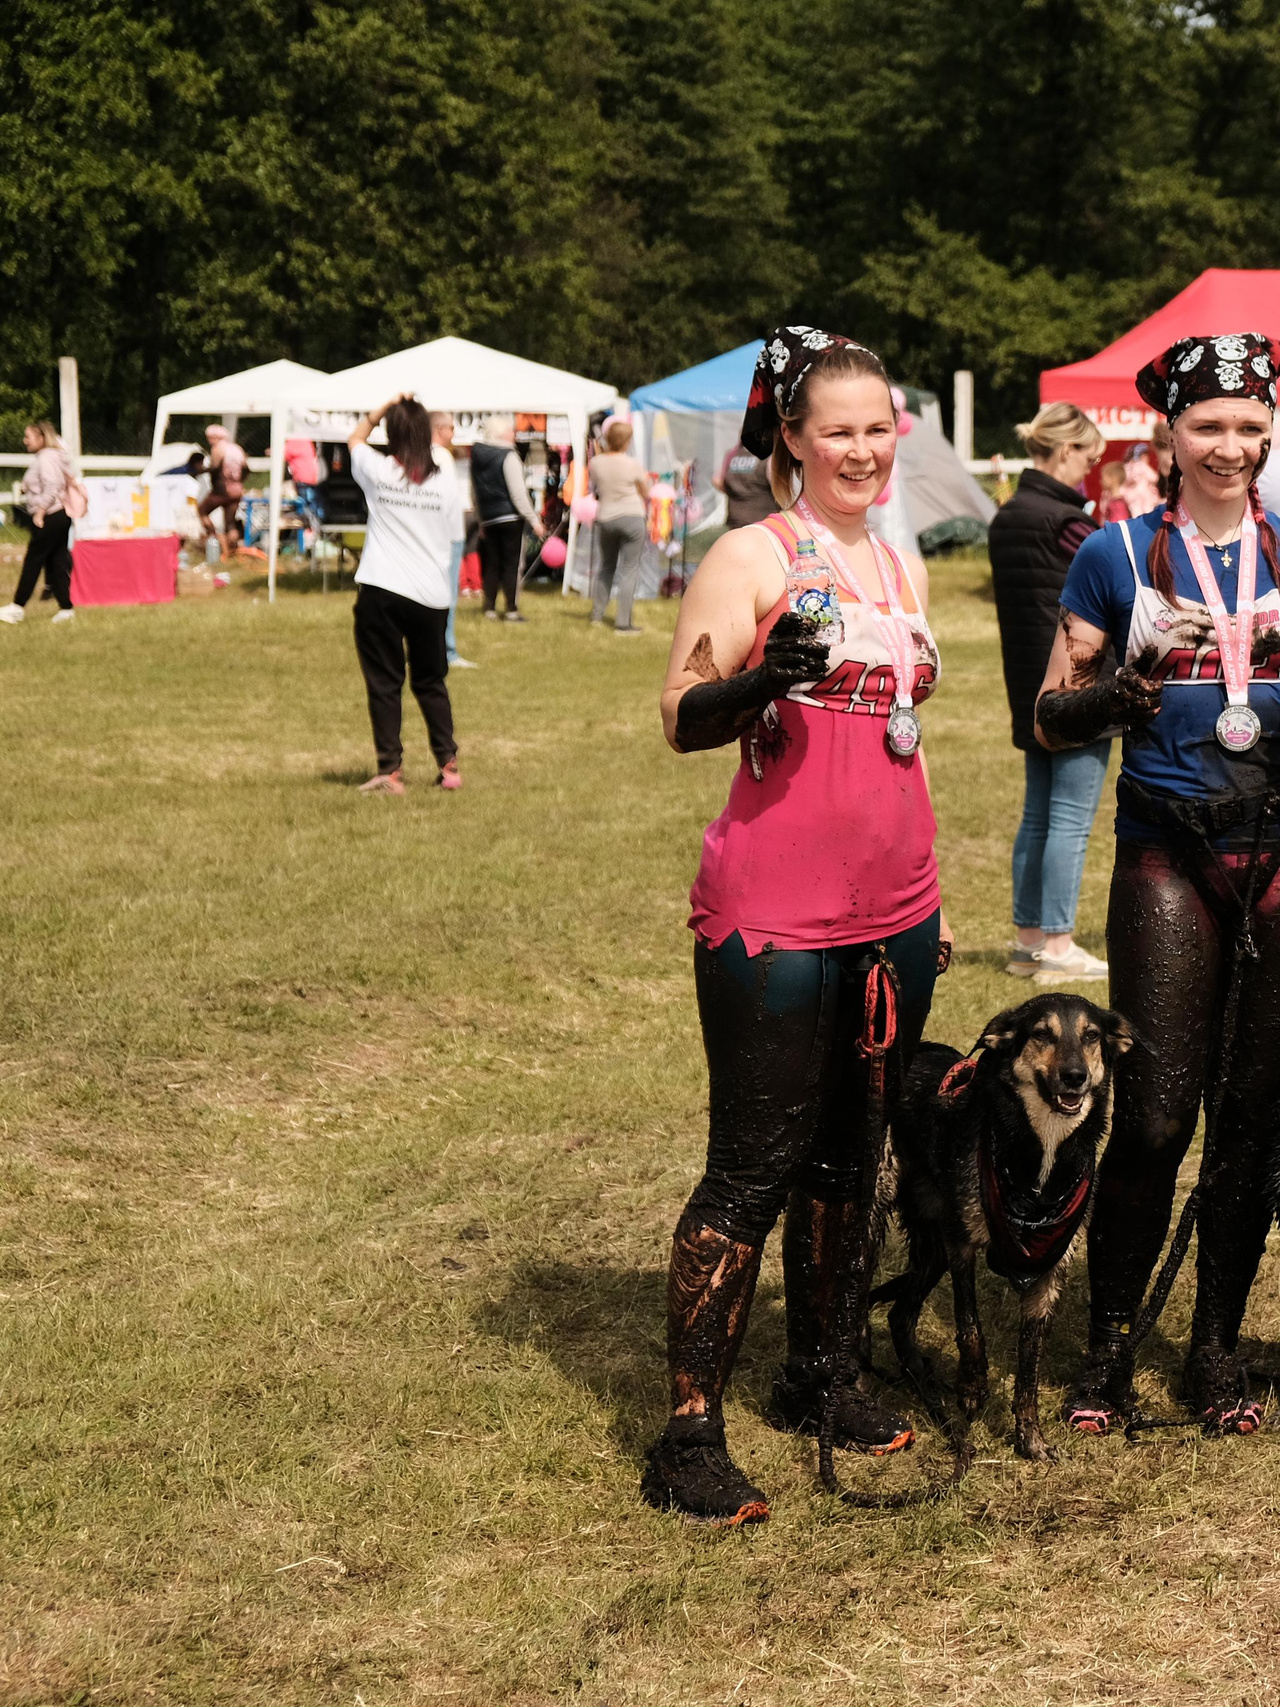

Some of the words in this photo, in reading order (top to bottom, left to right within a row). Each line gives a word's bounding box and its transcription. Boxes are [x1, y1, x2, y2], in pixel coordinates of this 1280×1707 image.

[1189, 540, 1202, 561] RACE
[1196, 561, 1208, 577] DOG
[1202, 578, 1217, 602] CRAZY
[1217, 619, 1228, 642] RACE
[1239, 614, 1247, 641] CRAZY
[1222, 643, 1232, 661] DOG
[1225, 661, 1238, 690] CRAZY
